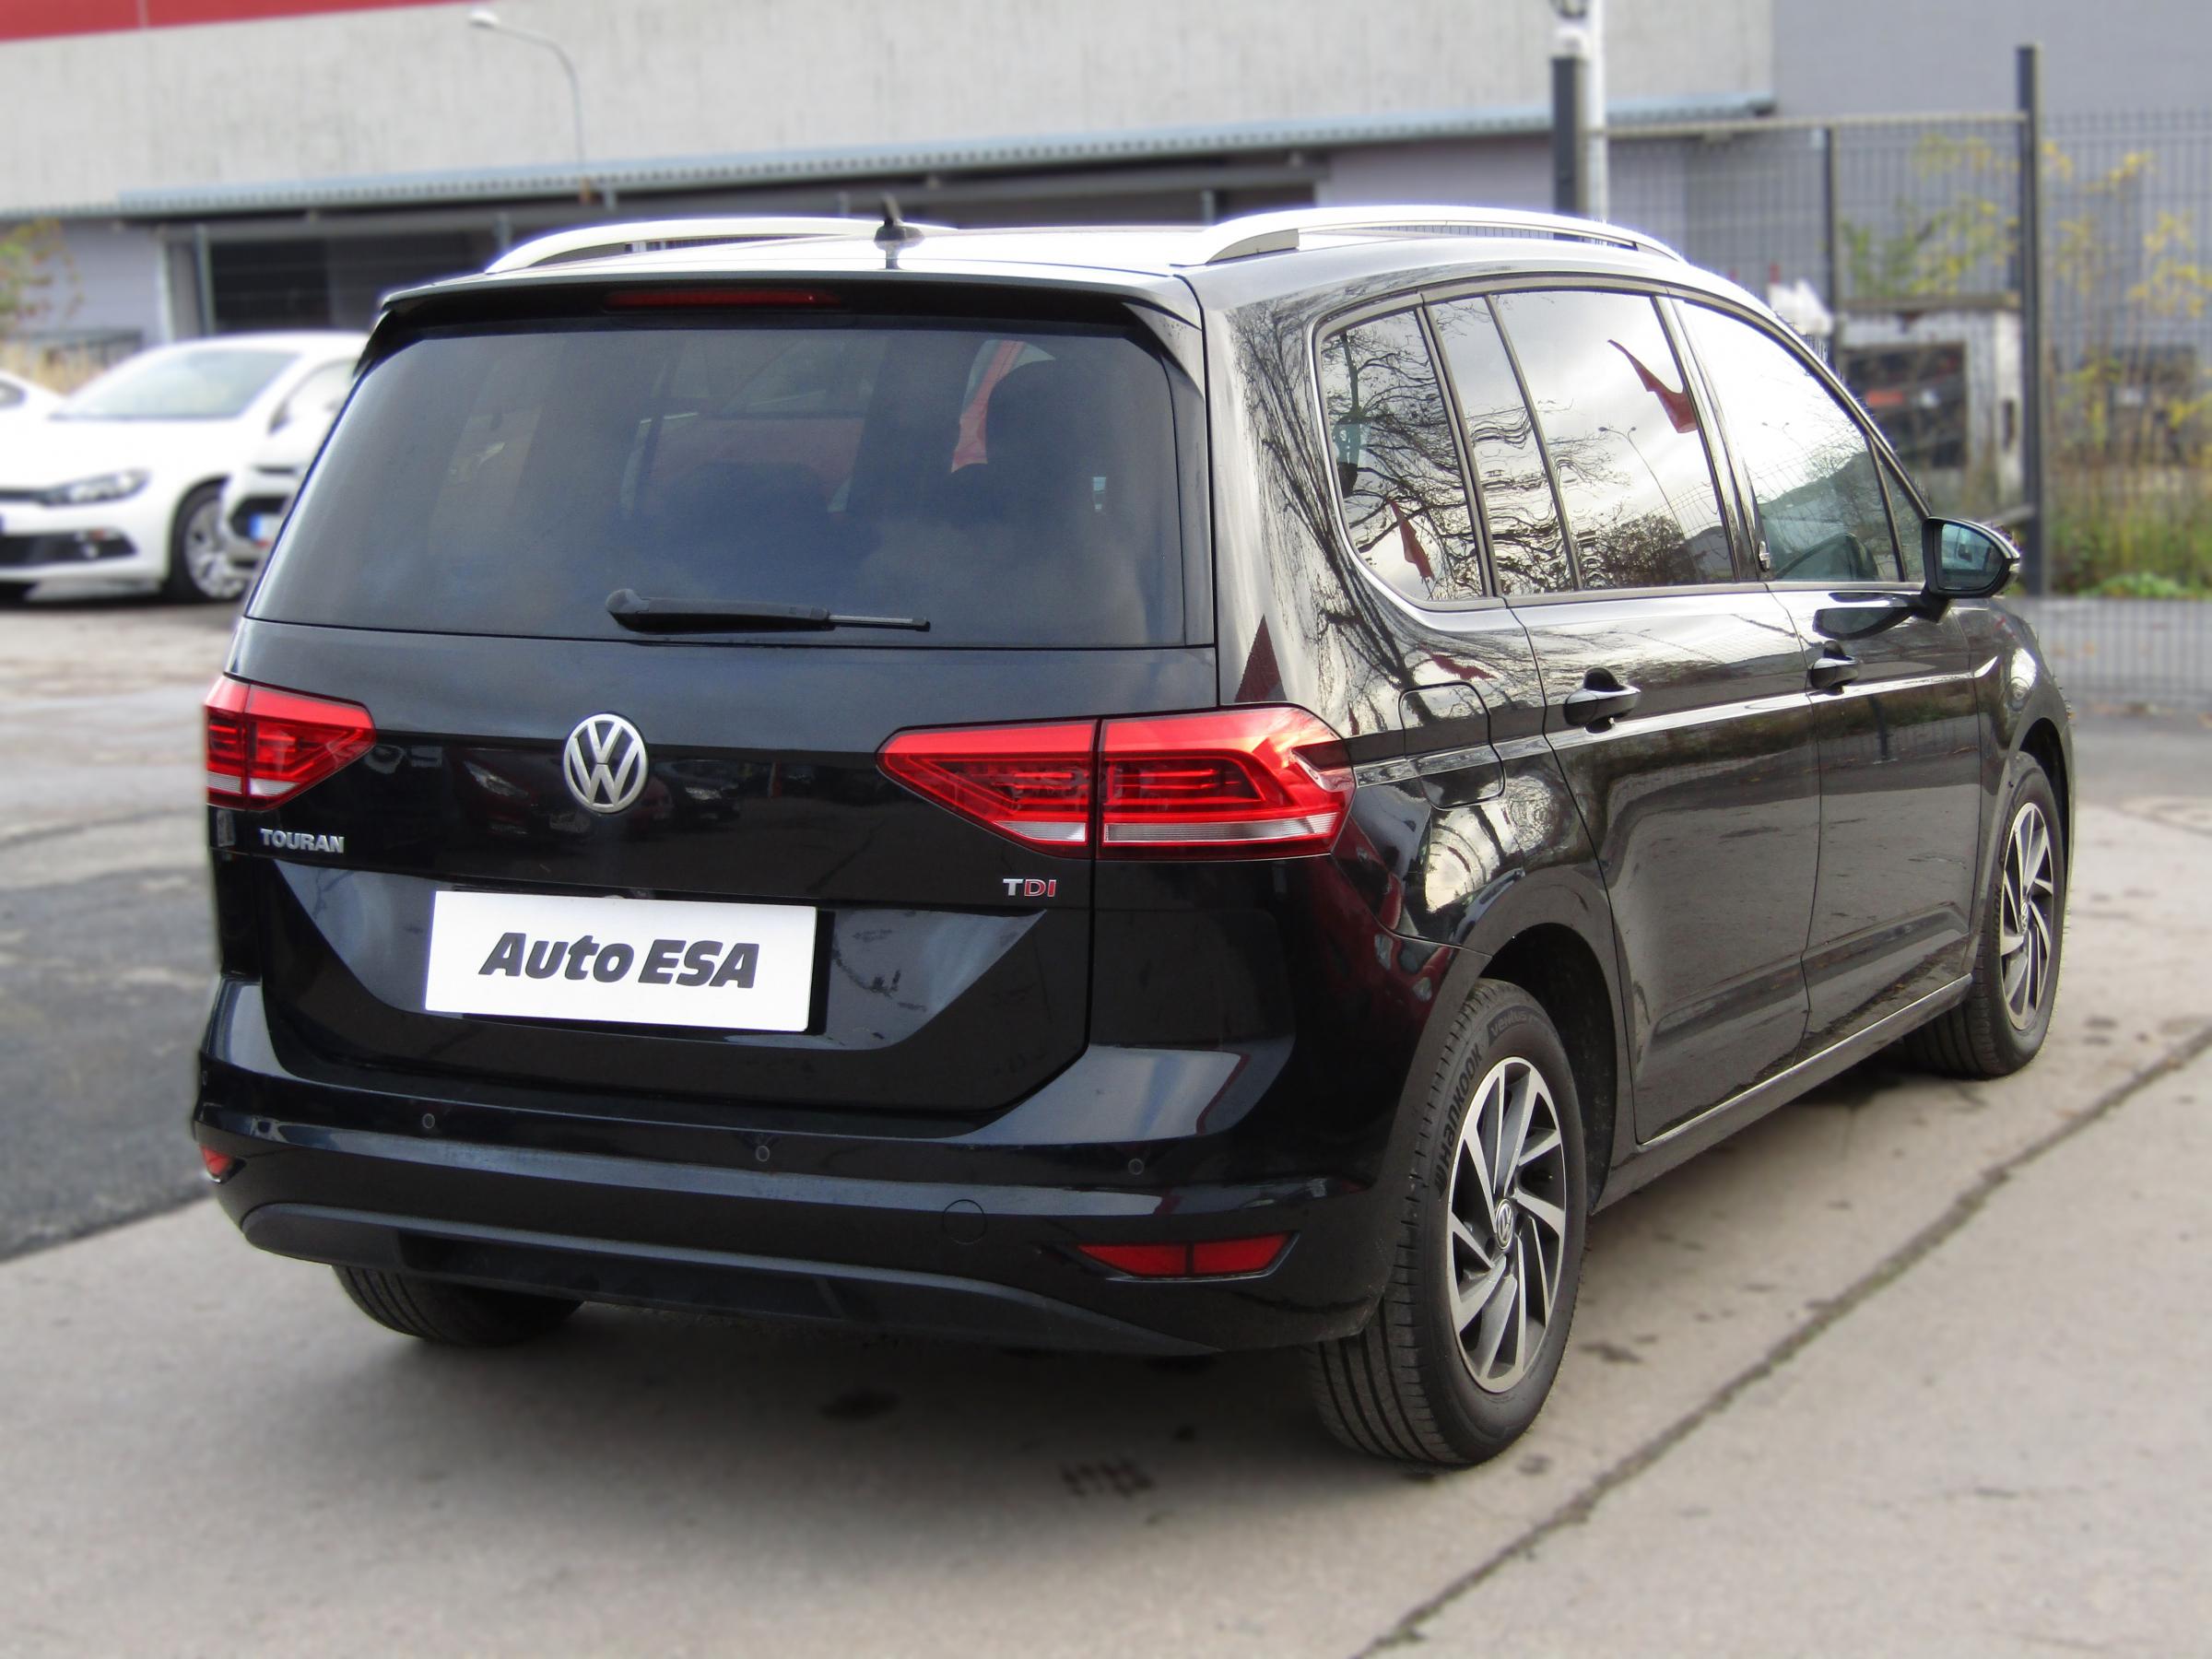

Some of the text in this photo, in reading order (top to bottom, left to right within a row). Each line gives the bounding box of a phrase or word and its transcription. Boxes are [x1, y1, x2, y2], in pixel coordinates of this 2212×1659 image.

[260, 828, 345, 853] TOURAN
[1002, 877, 1057, 898] TDI
[477, 931, 760, 989] Auto ESA
